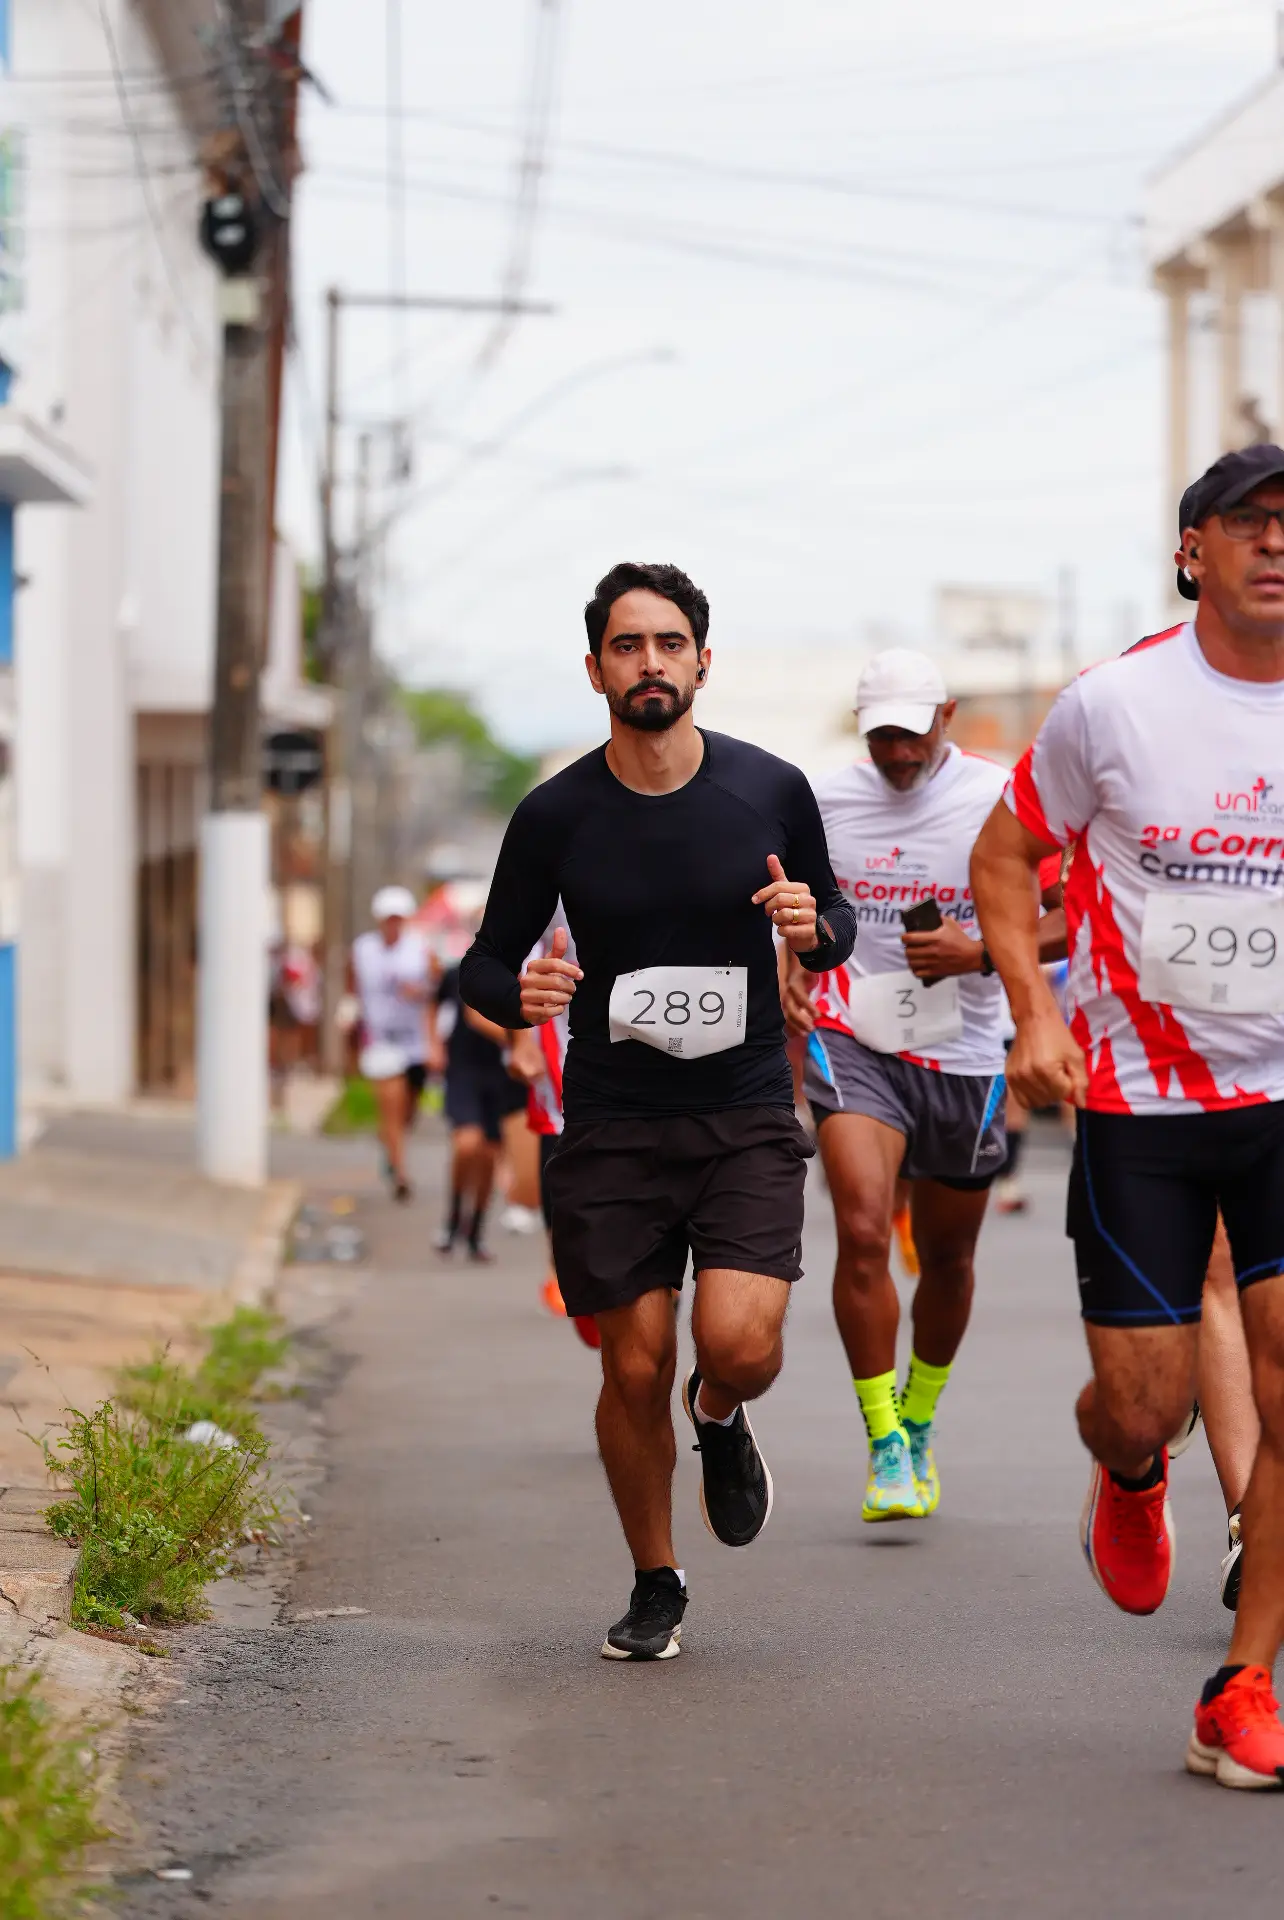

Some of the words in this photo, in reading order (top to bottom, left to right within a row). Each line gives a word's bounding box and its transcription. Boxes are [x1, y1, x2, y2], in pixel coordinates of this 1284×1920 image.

[1167, 923, 1277, 968] 299
[630, 989, 725, 1026] 289
[895, 988, 918, 1019] 3
